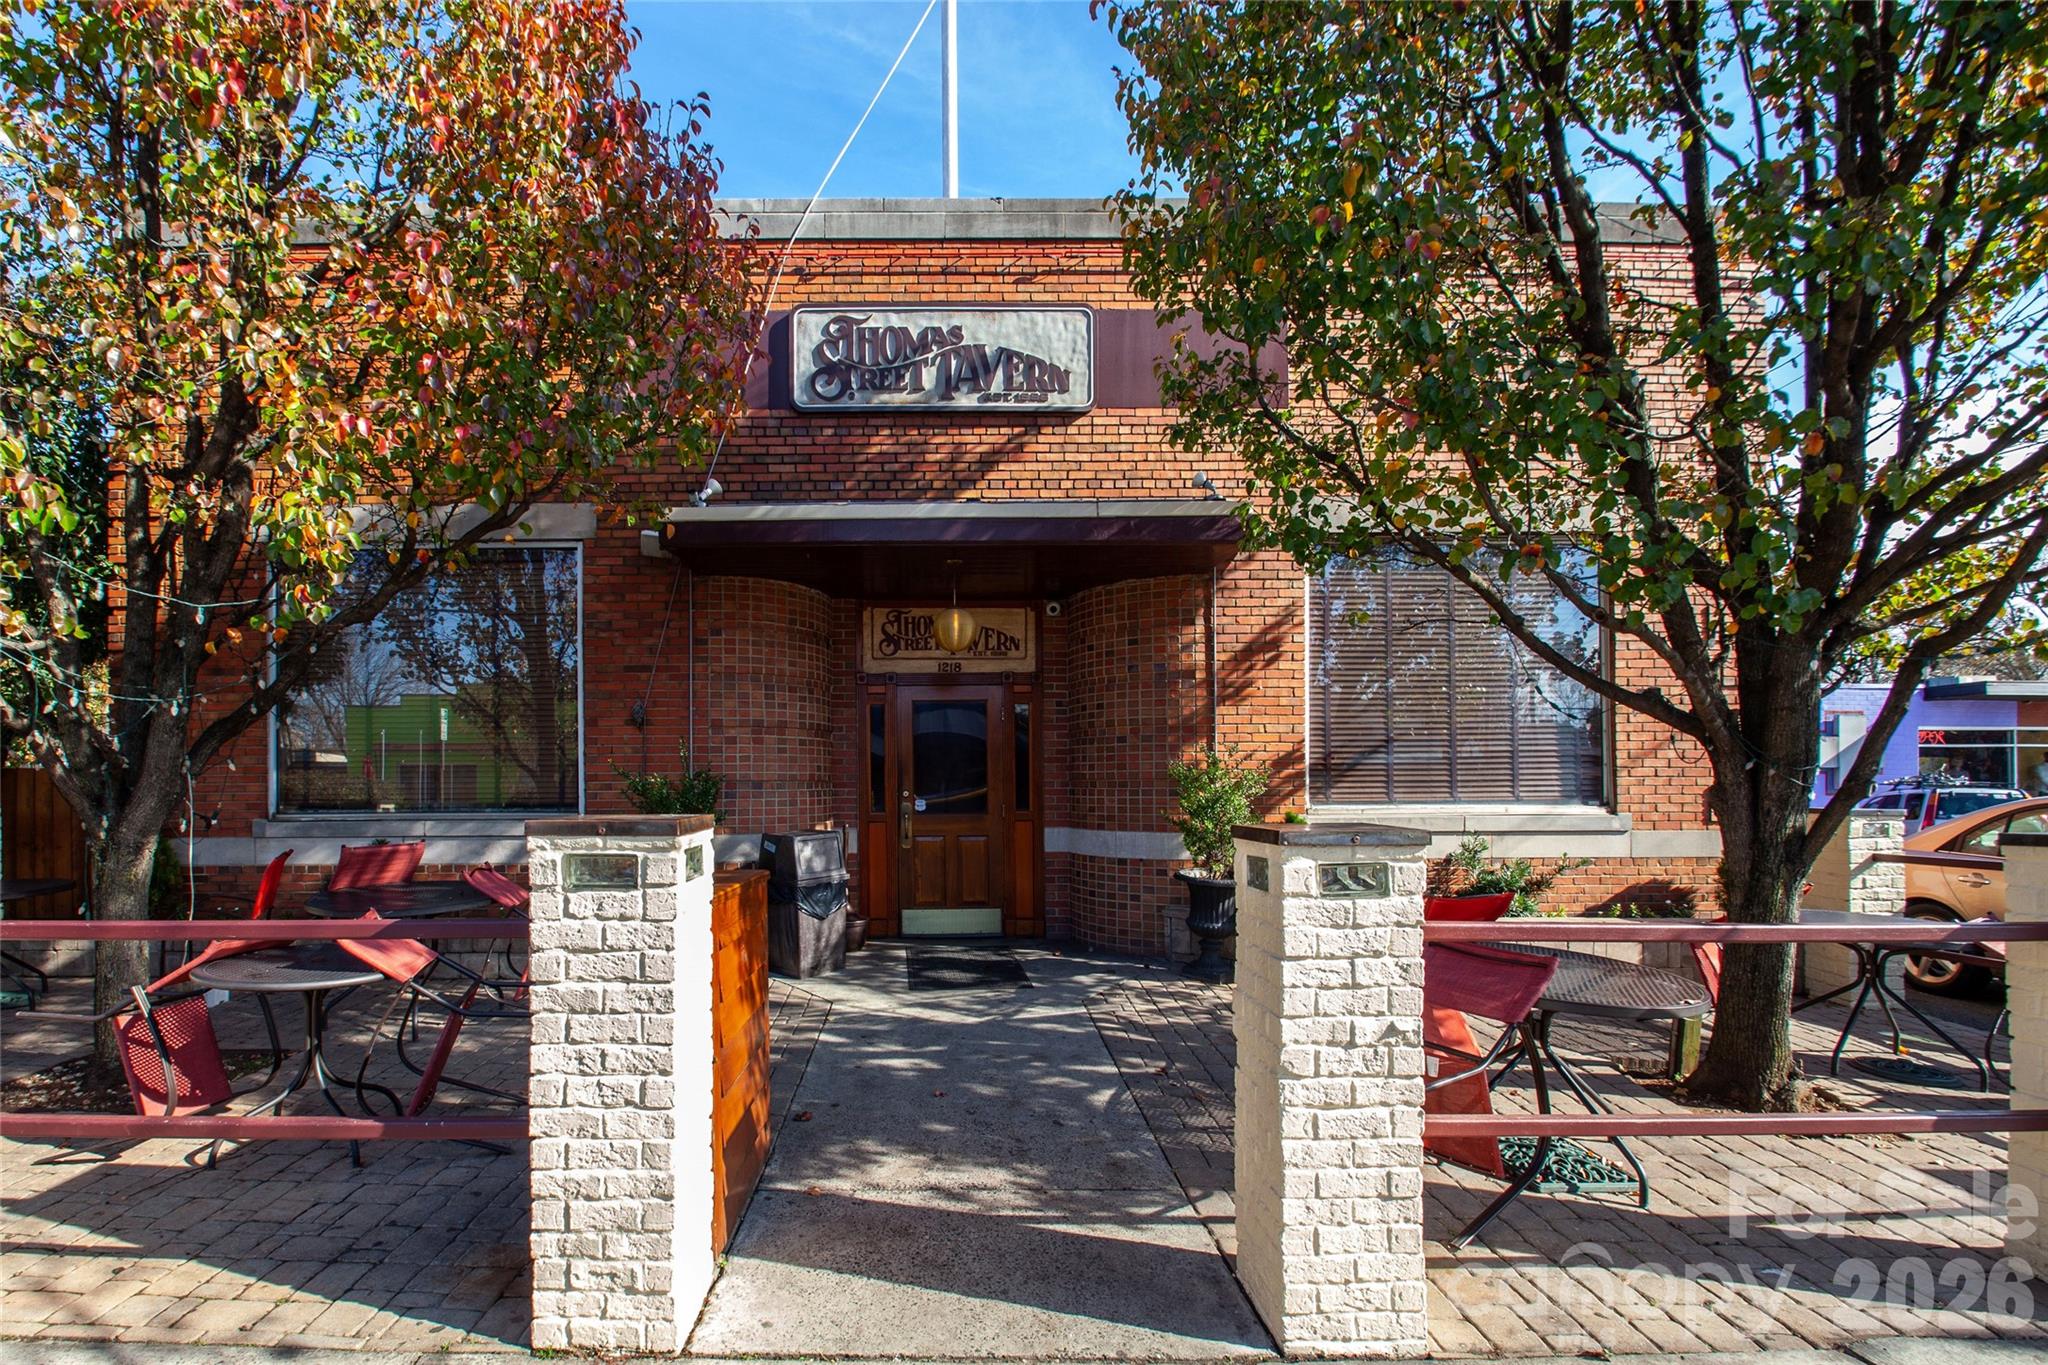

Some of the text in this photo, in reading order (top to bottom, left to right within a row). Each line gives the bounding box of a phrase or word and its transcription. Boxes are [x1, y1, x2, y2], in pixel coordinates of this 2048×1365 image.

[821, 314, 965, 367] THOMAS
[811, 338, 1072, 401] STREET TAVERN
[937, 662, 962, 673] 1218
